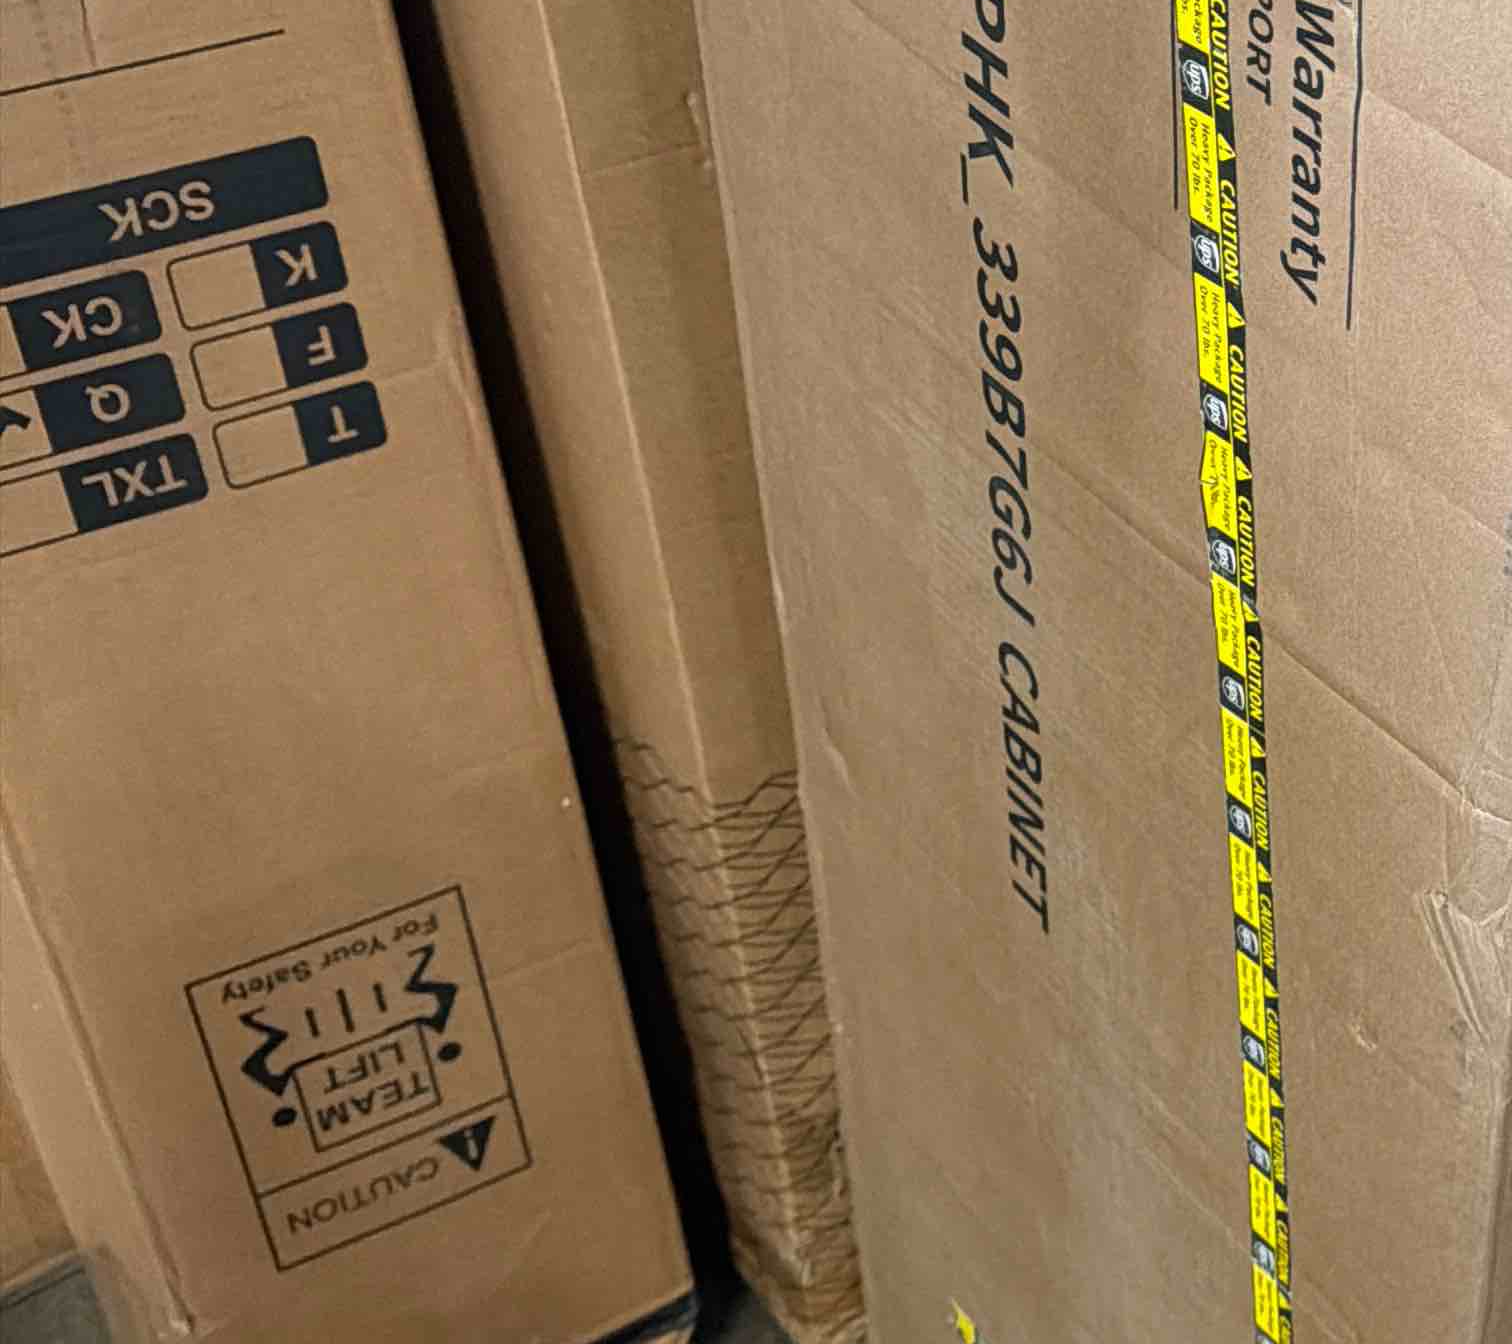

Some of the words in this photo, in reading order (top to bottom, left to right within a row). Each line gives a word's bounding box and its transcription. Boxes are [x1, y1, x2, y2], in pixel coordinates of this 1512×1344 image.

[98, 180, 217, 243] SCK
[274, 244, 319, 288] K
[40, 295, 123, 350] CK
[306, 324, 337, 367] F
[84, 383, 131, 424] Q
[327, 405, 359, 443] T
[80, 453, 189, 508] TXL
[998, 640, 1050, 935] CABINET
[319, 934, 388, 971] Your
[392, 912, 440, 943] For
[220, 958, 312, 1005] Safety
[322, 1040, 406, 1095] LIFT
[316, 1070, 431, 1132] TEAM
[285, 1155, 440, 1235] CAUTION
